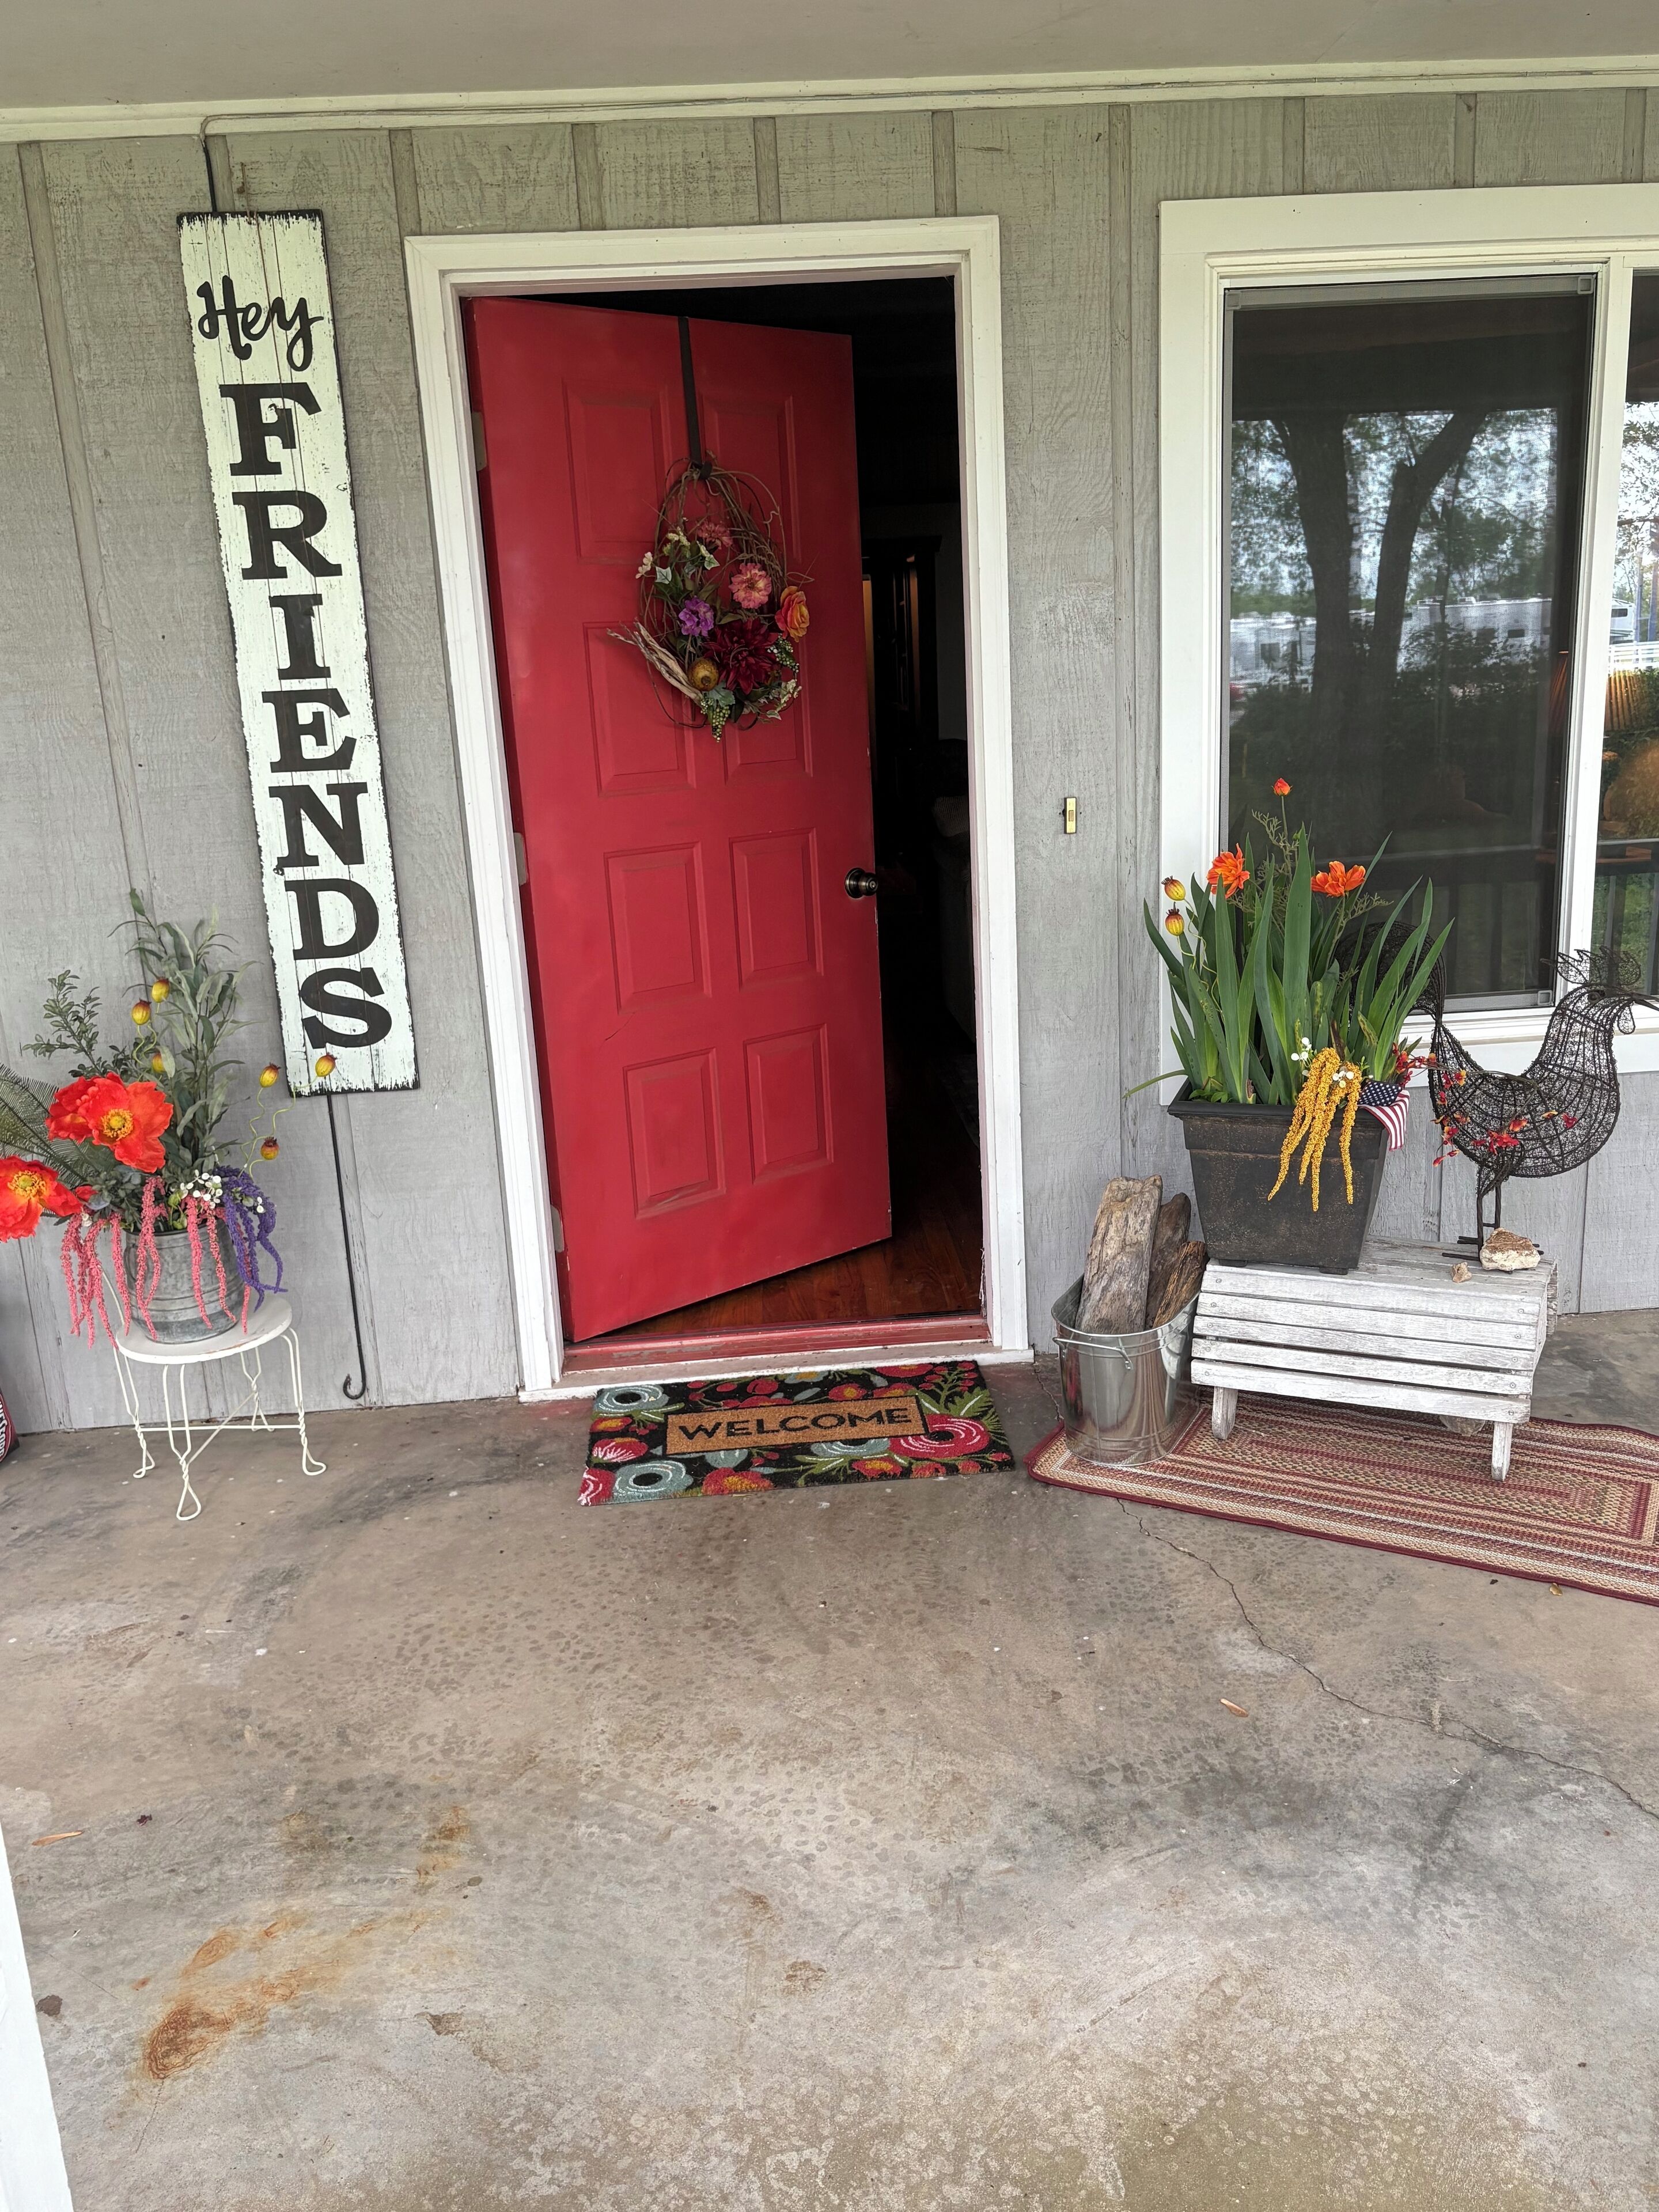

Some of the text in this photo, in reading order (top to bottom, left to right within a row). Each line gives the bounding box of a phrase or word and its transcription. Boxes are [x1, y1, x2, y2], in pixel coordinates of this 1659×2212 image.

[196, 275, 324, 372] Hey
[219, 381, 393, 1050] FRIENDS
[678, 1407, 912, 1440] WELCOME
